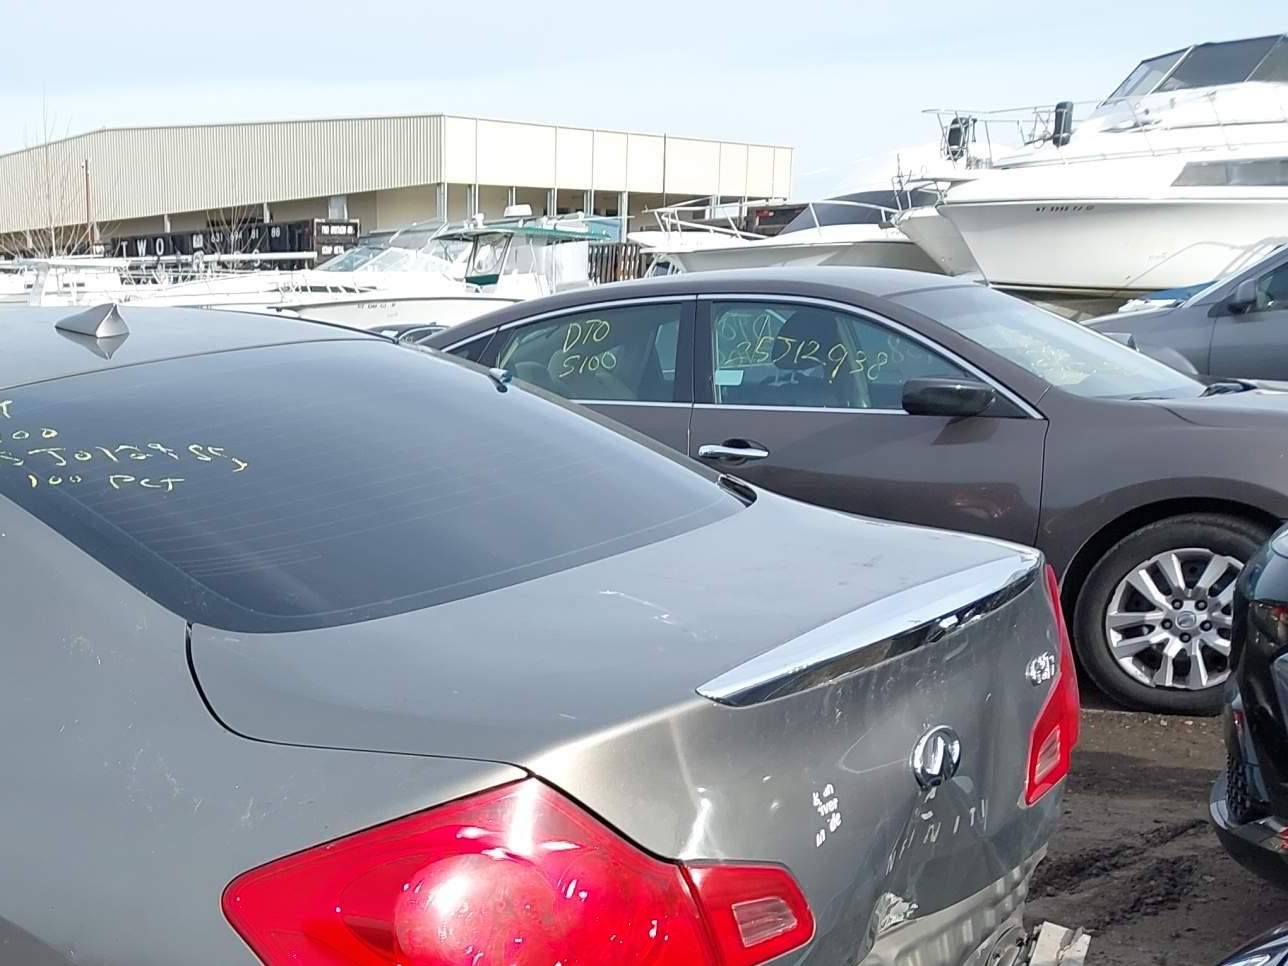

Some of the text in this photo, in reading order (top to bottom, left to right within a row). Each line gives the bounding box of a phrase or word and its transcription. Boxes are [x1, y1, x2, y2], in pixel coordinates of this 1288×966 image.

[120, 237, 165, 259] TWO
[562, 319, 610, 353] DTO
[559, 351, 617, 378] S100
